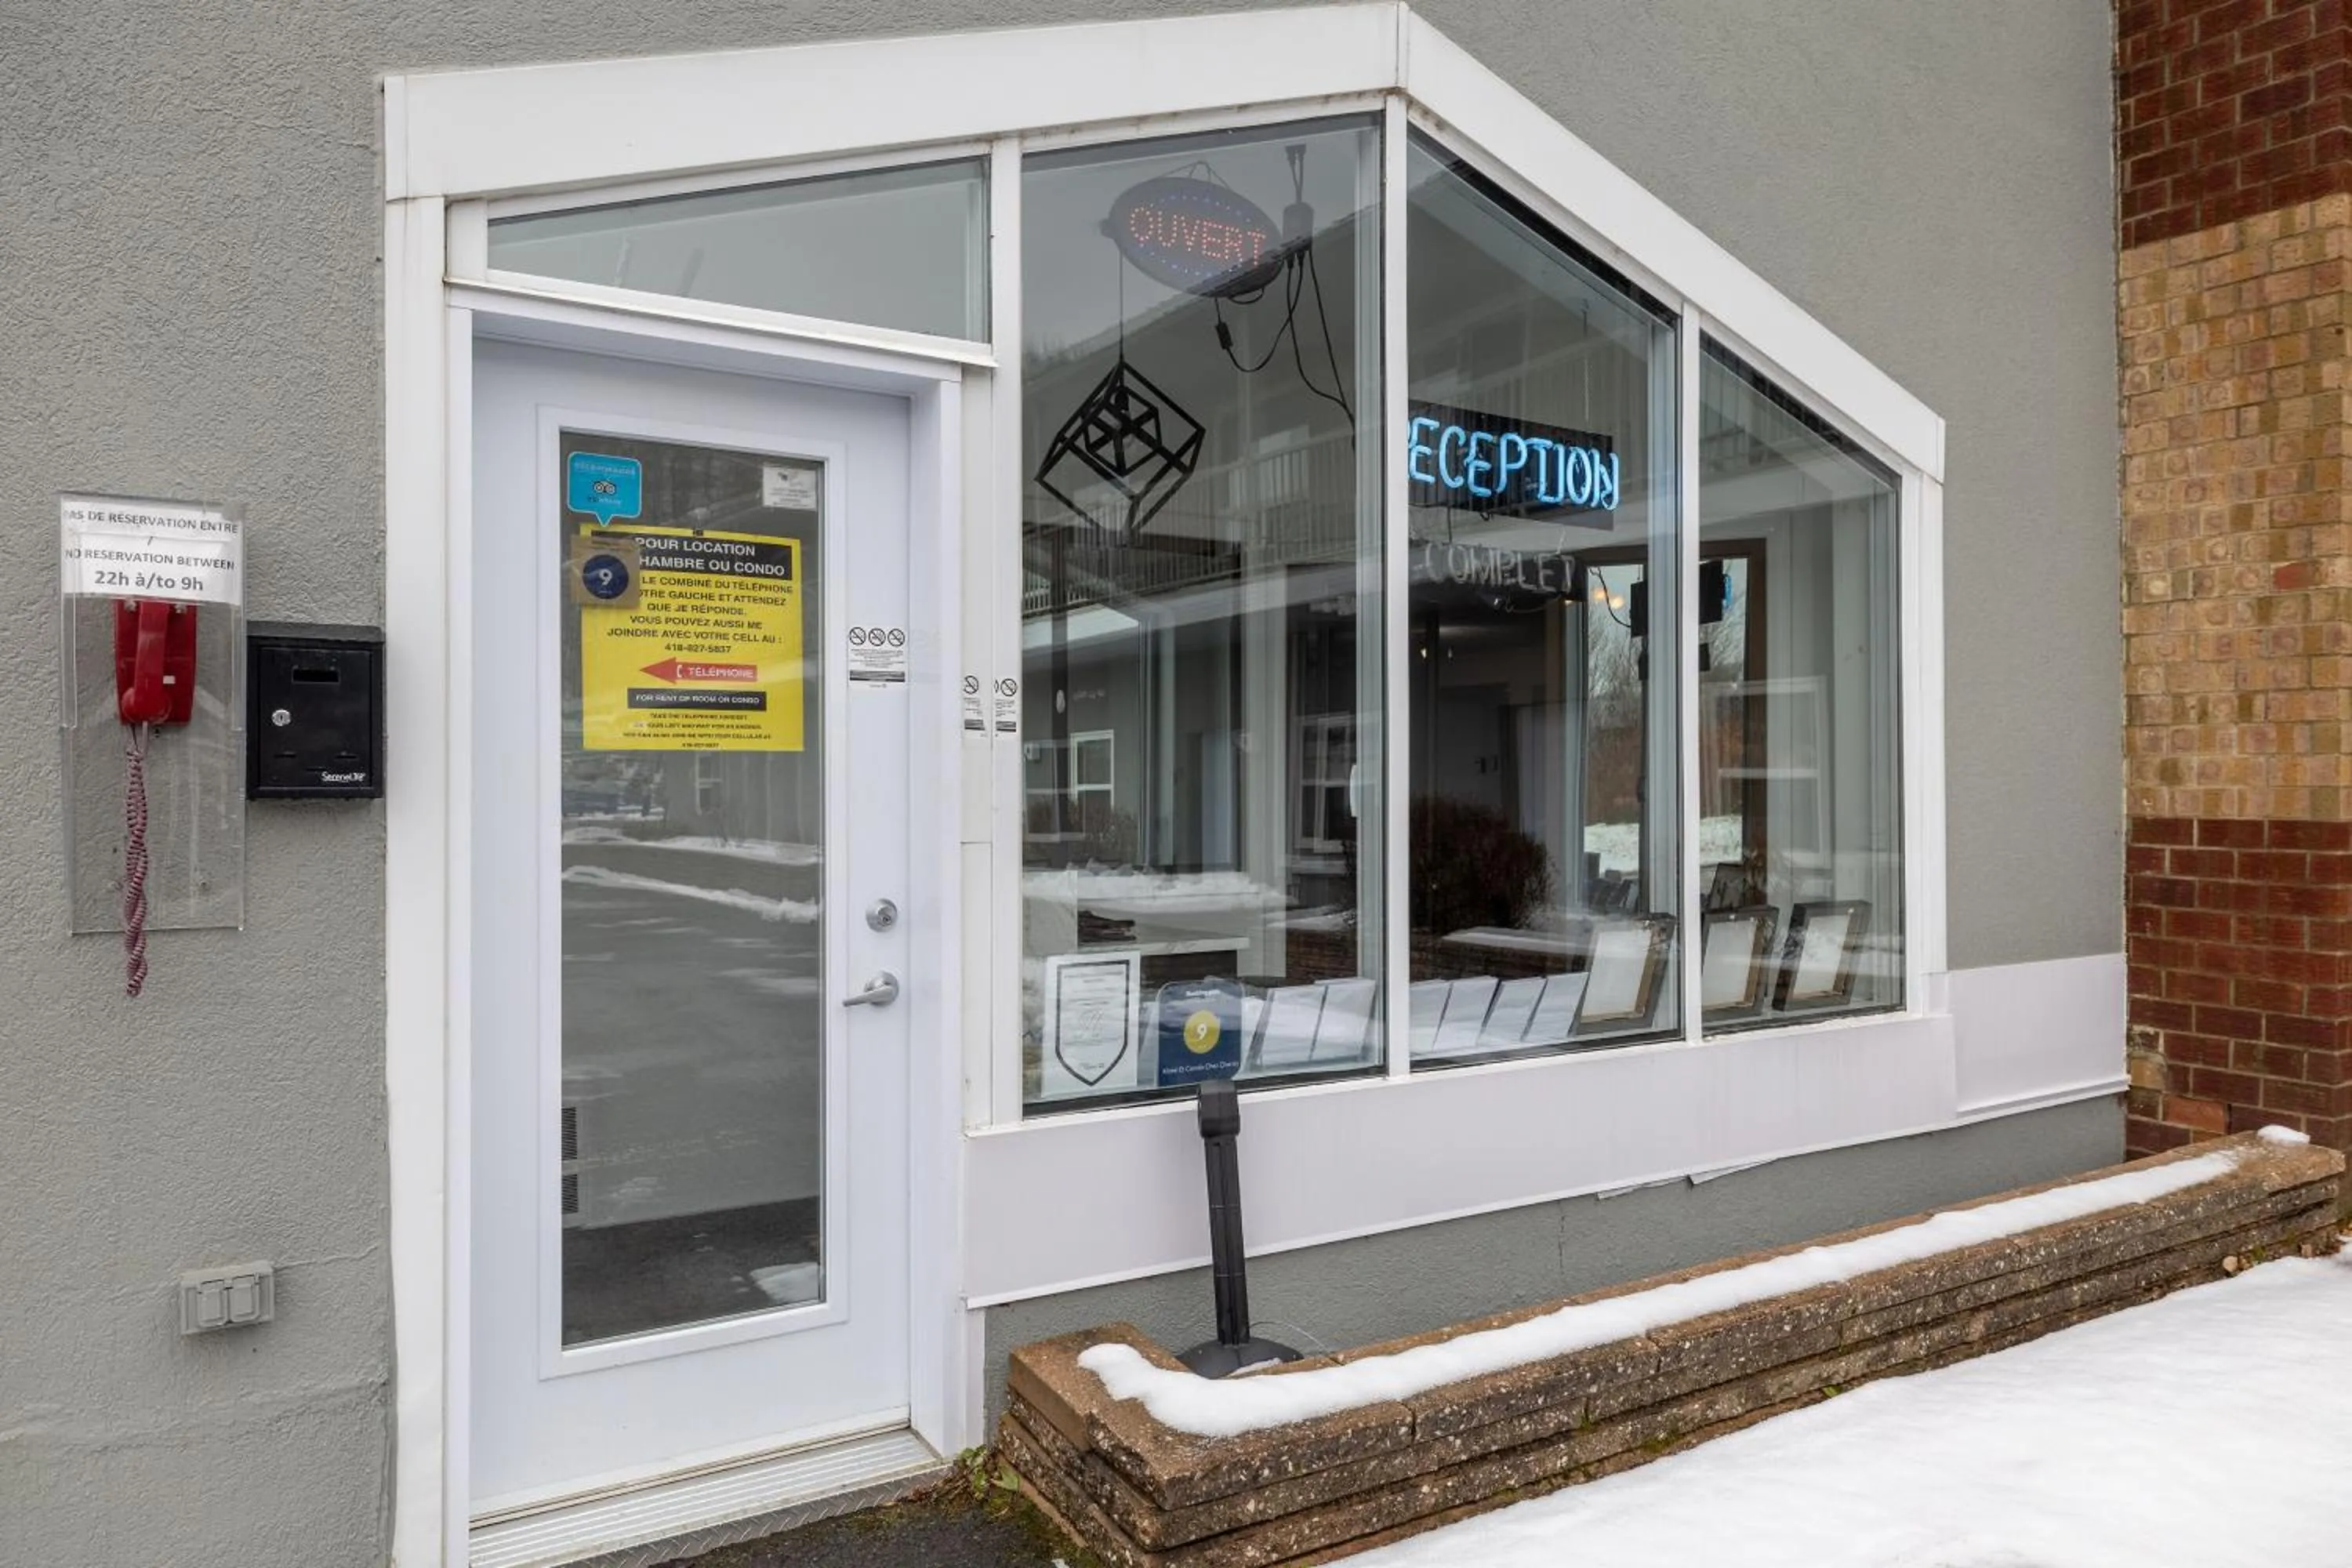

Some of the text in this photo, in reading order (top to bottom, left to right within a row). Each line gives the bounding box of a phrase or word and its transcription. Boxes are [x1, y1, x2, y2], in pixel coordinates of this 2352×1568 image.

[1129, 206, 1266, 266] OUVERT
[1408, 416, 1620, 510] ECEPTION
[88, 510, 105, 521] DE
[200, 521, 238, 533] ENTRE
[634, 537, 679, 550] POUR
[683, 540, 755, 556] LOCATION
[85, 550, 173, 564] RESERVATION
[176, 556, 234, 571] BETWEEN
[640, 557, 785, 576] HAMBRE OU CONDO
[1423, 542, 1575, 594] COMPLET
[94, 570, 129, 586] 22h
[180, 576, 204, 591] 9h
[599, 568, 613, 586] 9
[642, 576, 657, 585] LE
[714, 580, 731, 590] DU
[669, 590, 715, 601] GAUCHE
[718, 593, 731, 602] ET
[733, 594, 786, 606] ATTENDEZ
[647, 603, 672, 612] QUE
[674, 604, 688, 613] JE
[630, 615, 763, 630] VOUS POUVEZ AUSSI ME
[607, 627, 659, 638] JOINDRE
[661, 629, 691, 640] AVEC
[694, 630, 730, 641] VOTRE
[732, 632, 760, 643] CELL
[761, 634, 775, 644] AU
[1196, 1022, 1207, 1041] 9
